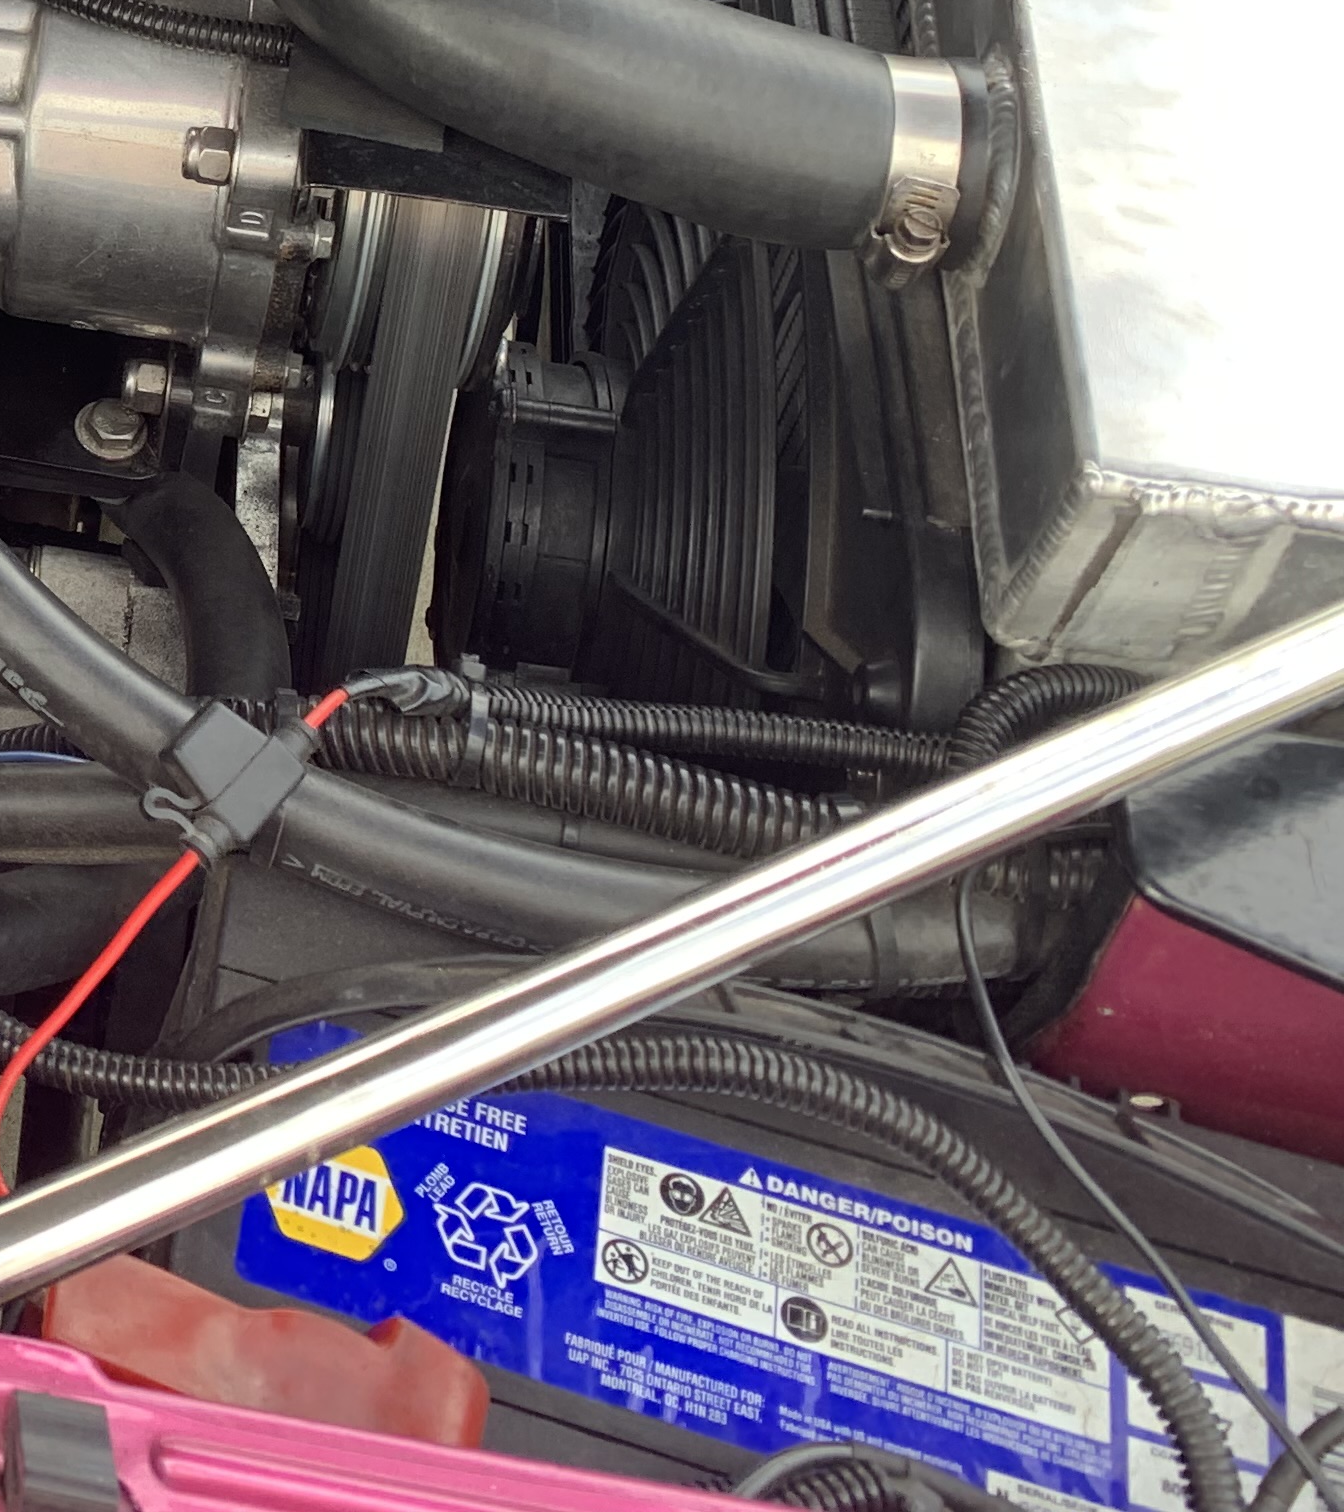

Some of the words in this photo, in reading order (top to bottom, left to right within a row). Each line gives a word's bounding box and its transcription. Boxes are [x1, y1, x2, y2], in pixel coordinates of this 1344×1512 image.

[413, 1112, 510, 1153] TRETIEN
[475, 1100, 529, 1136] FREE
[281, 1162, 378, 1234] NAPA
[414, 1161, 450, 1199] PLOMB
[427, 1174, 457, 1204] LEAD
[531, 1200, 563, 1257] RETURN
[541, 1199, 574, 1255] RETOUR
[766, 1174, 974, 1255] DANGER/POISON
[451, 1274, 515, 1305] RECYCLE
[652, 1256, 672, 1270] KEEP
[674, 1262, 690, 1277] OUT
[705, 1271, 721, 1285] THE
[723, 1276, 751, 1296] REACH
[698, 1282, 722, 1299] TENIR
[440, 1282, 525, 1320] RECYCLAGE
[683, 1289, 700, 1303] DES
[564, 1331, 615, 1359] FABRIQUÉ
[616, 1348, 647, 1368] POUR
[654, 1359, 739, 1399] MANUFACTURED
[568, 1349, 590, 1366] UAP
[619, 1362, 645, 1382] 7025
[646, 1373, 693, 1399] ONTARIO
[694, 1387, 732, 1411] STREET
[684, 1399, 707, 1420] H1N
